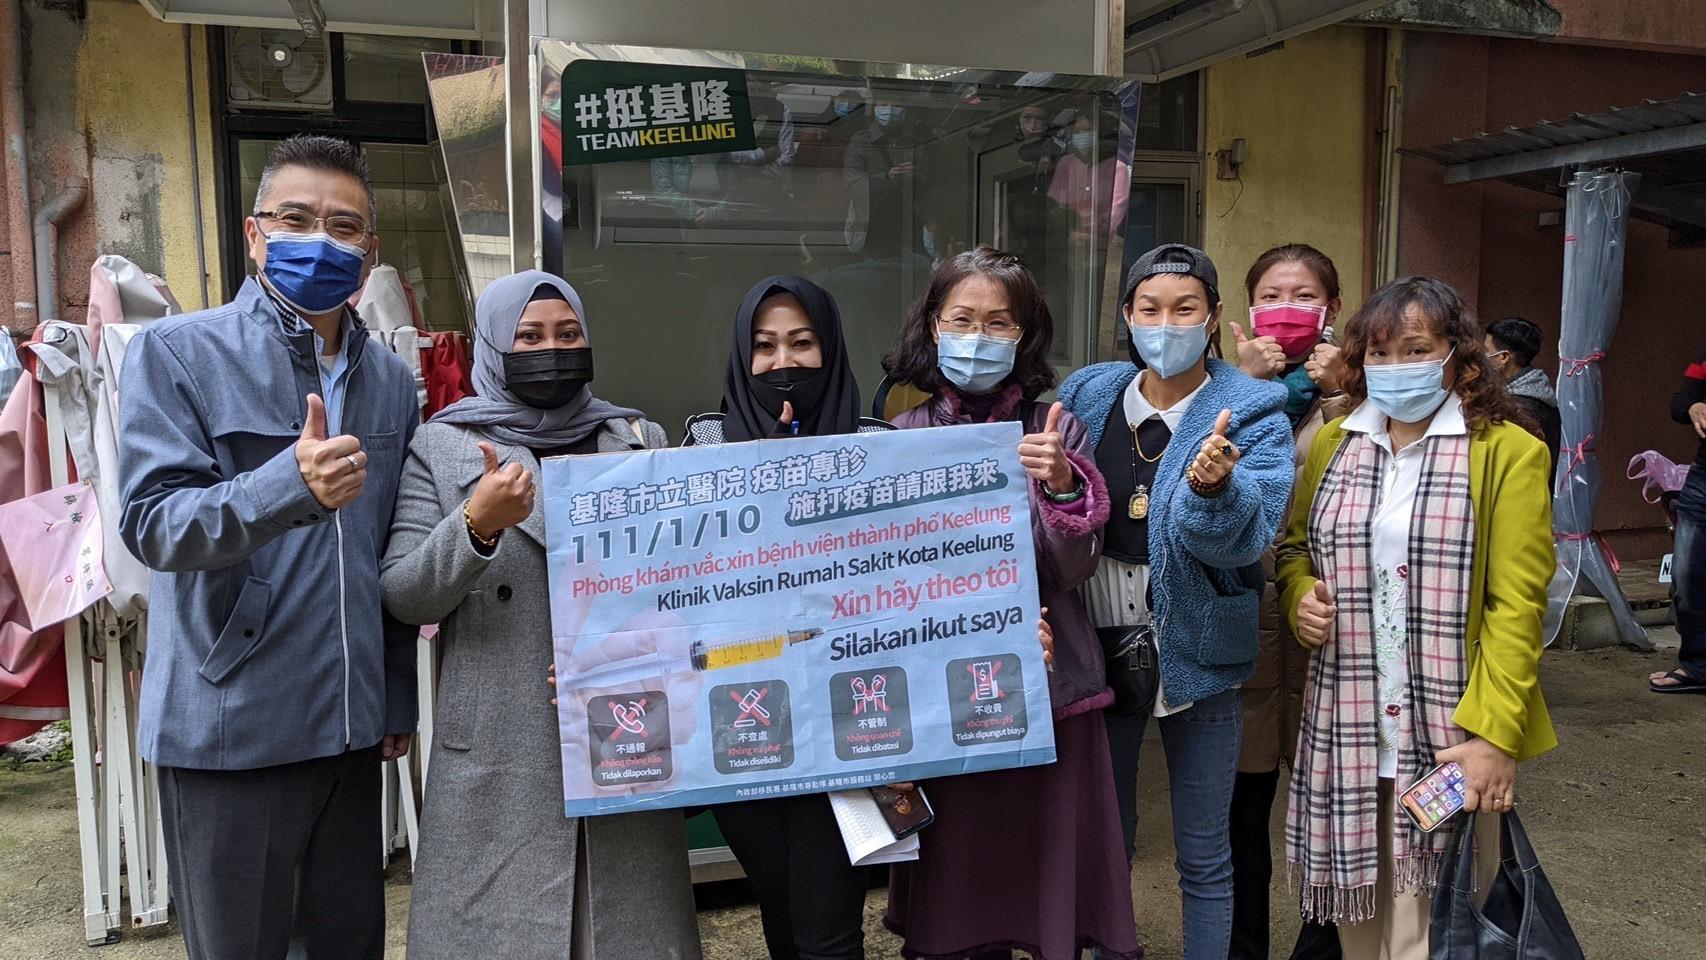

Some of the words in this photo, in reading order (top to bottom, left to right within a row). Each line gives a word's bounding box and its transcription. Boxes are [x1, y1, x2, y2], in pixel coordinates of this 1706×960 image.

[574, 79, 733, 129] #挺基隆
[576, 121, 736, 151] TEAMKEELUNG
[569, 466, 746, 526] 基隆市立醫院
[751, 444, 868, 494] 疫苗專診
[789, 457, 999, 521] 施打疫苗請跟我來
[572, 505, 761, 564] 111/1/10
[573, 572, 634, 598] Phòng
[636, 560, 690, 587] khám
[693, 551, 724, 577] vắc
[727, 550, 755, 571] xin
[757, 540, 804, 568] bệnh
[807, 532, 845, 558] viện
[847, 522, 900, 548] thành
[904, 512, 939, 541] phố
[942, 504, 1011, 530] Keelung
[657, 585, 711, 612] Klinik
[712, 574, 774, 602] Vaksin
[778, 561, 844, 591] Rumah
[848, 551, 894, 576] Sakit
[897, 546, 938, 567] Kota
[942, 532, 1014, 559] Keelung
[831, 589, 871, 620] Xin
[876, 578, 923, 611] hãy
[926, 573, 982, 601] theo
[985, 558, 1018, 588] tôi
[830, 628, 917, 661] Silakan
[922, 613, 967, 643] ikut
[970, 606, 1022, 634] saya
[858, 717, 887, 729] 不管制
[975, 703, 1002, 715] 不收費
[616, 742, 646, 754] 不通報
[851, 744, 871, 754] Tidak
[871, 740, 899, 752] dibatasi
[956, 732, 975, 741] Tidak
[975, 729, 1006, 740] dipungut
[1006, 727, 1025, 736] biaya
[601, 771, 622, 780] Tidak
[622, 767, 662, 778] dilaporkan
[729, 759, 750, 768] Tidak
[750, 754, 781, 766] diselidiki
